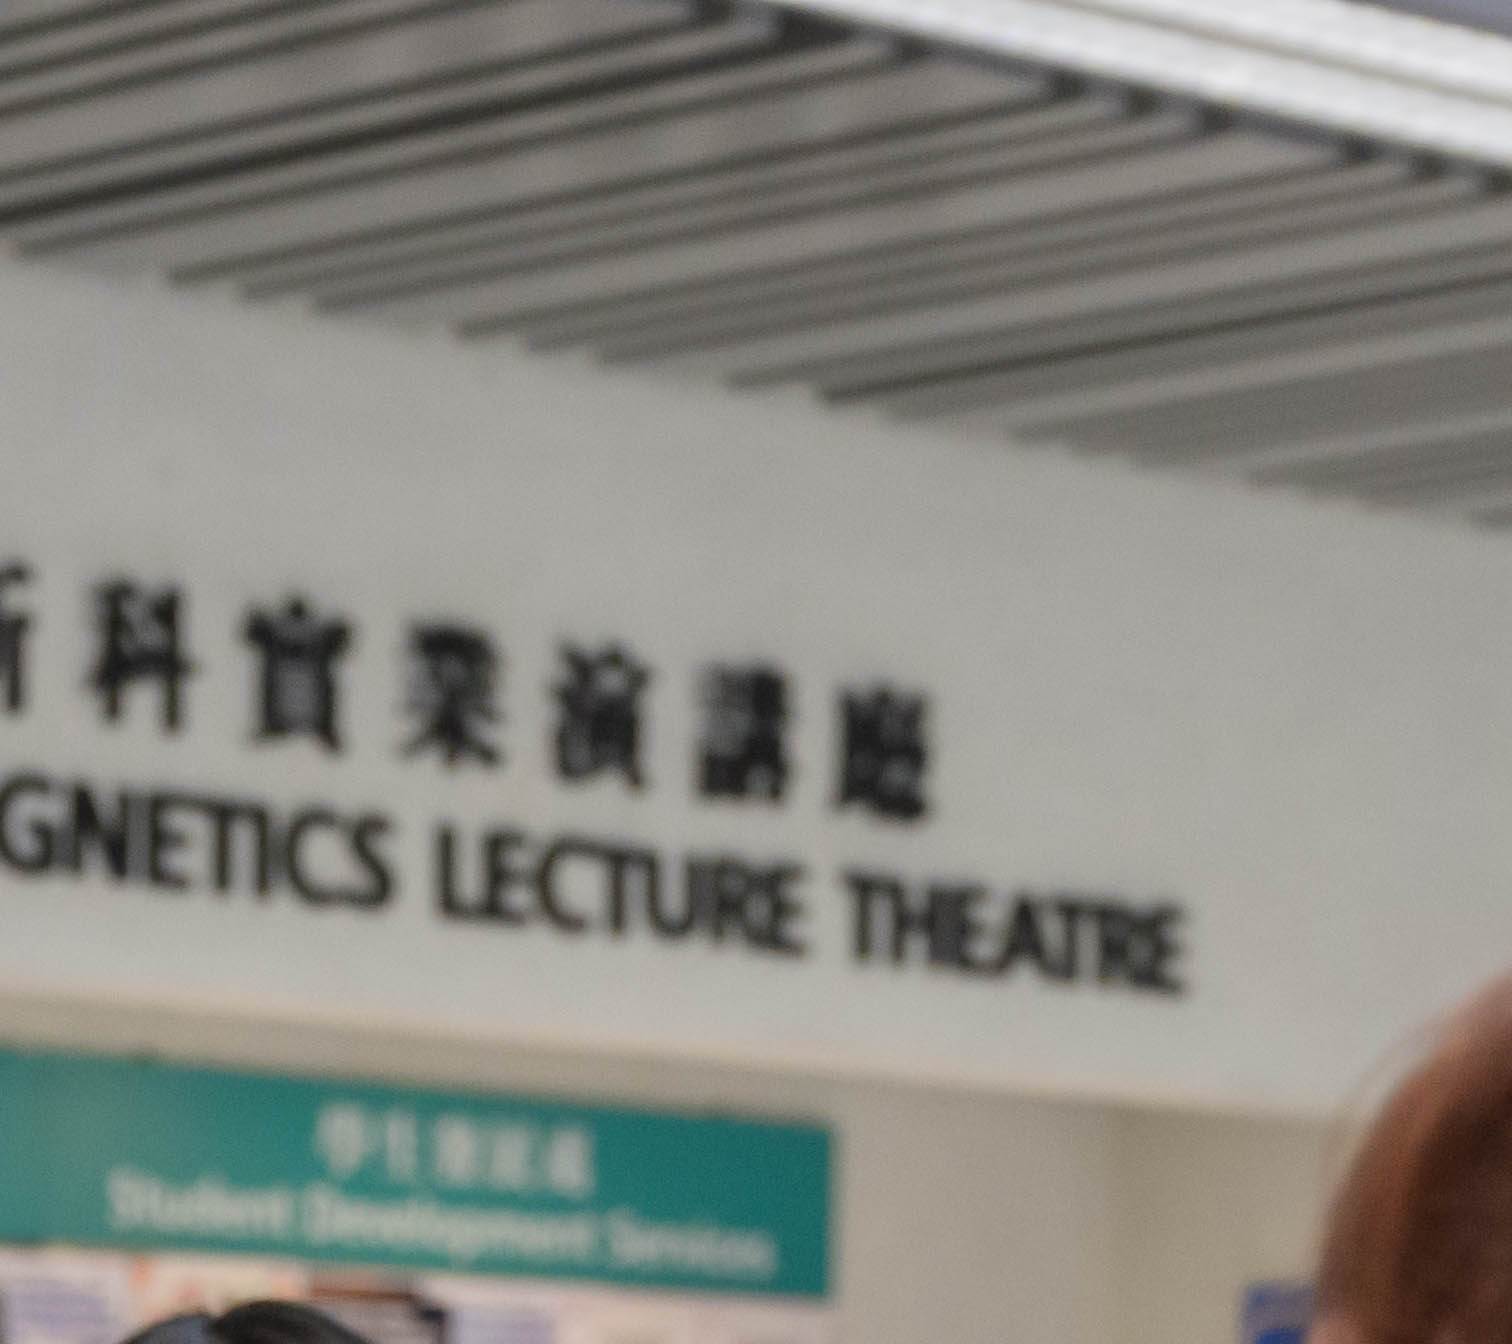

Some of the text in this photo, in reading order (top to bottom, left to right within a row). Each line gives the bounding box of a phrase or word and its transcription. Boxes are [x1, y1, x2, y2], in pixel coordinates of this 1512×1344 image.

[430, 822, 814, 962] LECTURE
[843, 870, 1193, 998] THEATRE
[106, 1165, 774, 1281] Student Development Services
